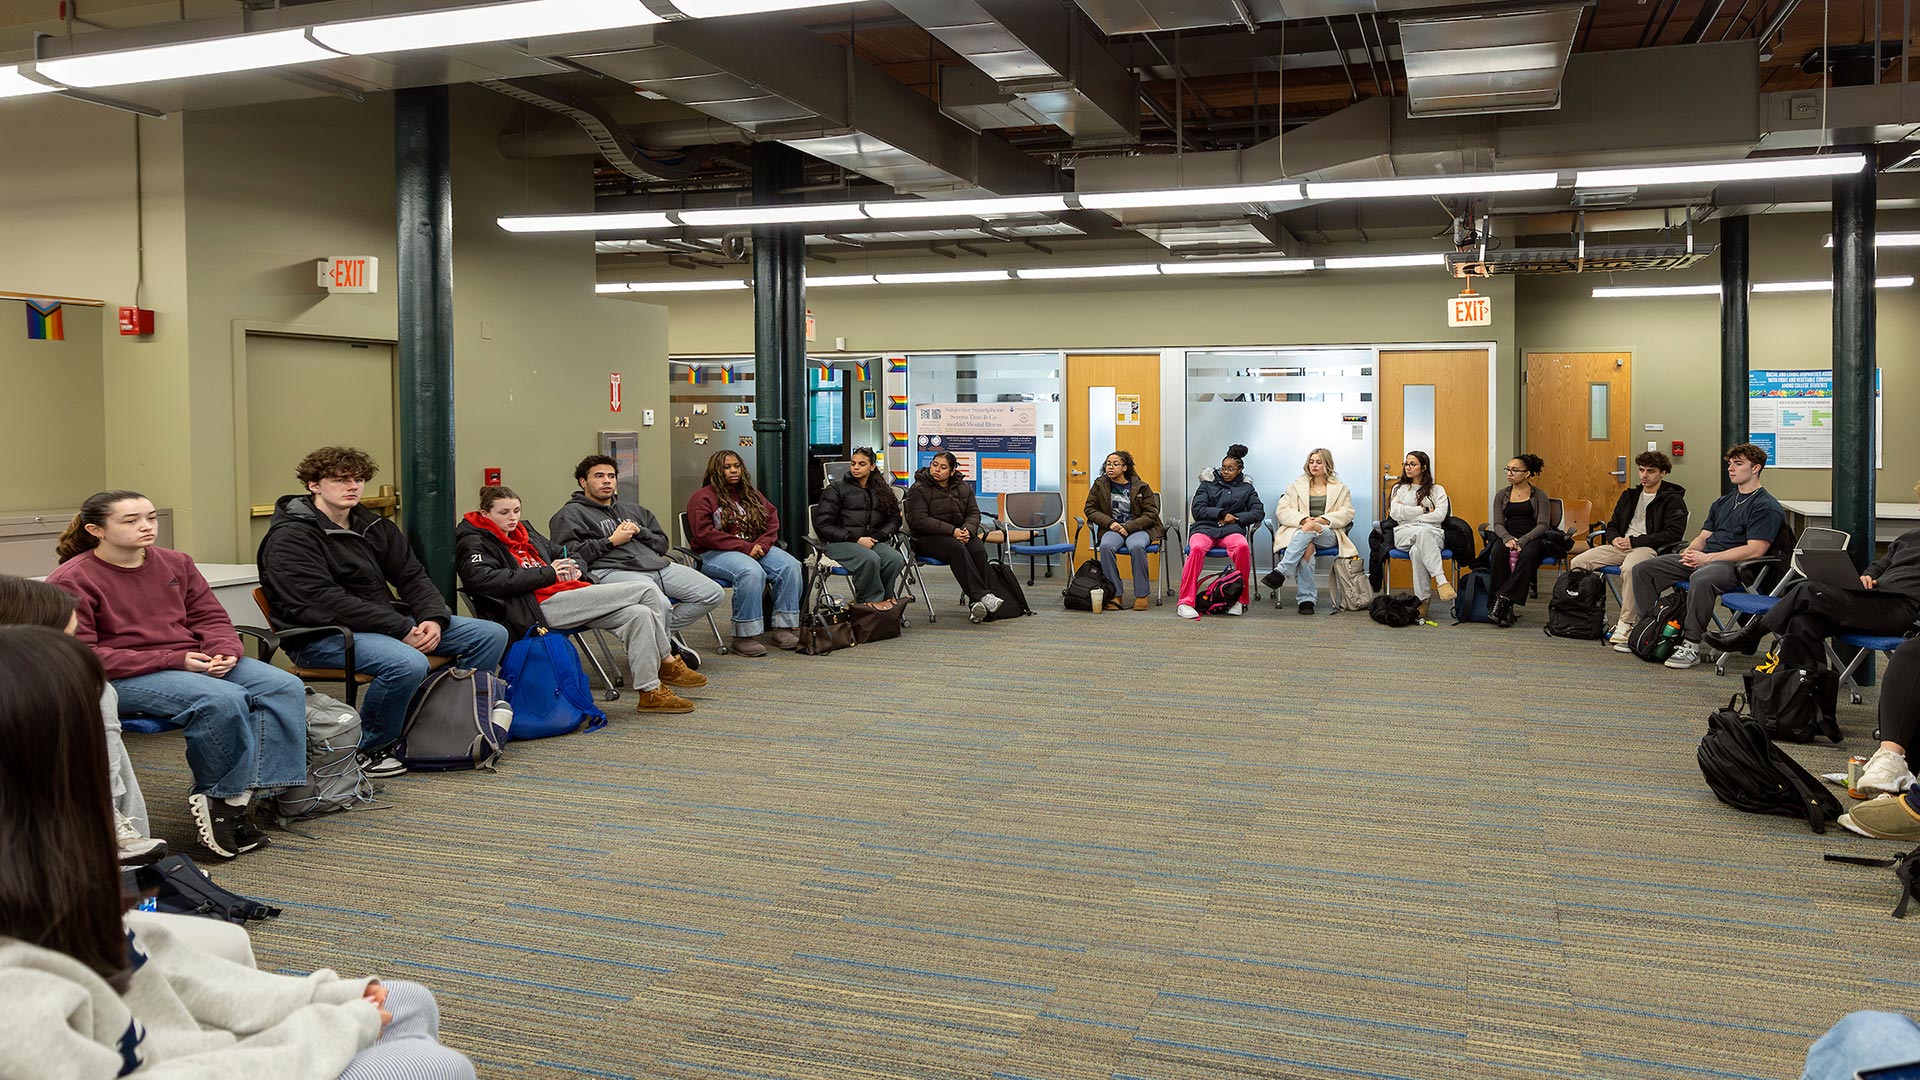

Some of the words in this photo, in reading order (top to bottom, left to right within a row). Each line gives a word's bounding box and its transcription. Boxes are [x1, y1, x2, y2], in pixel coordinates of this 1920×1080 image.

[335, 259, 365, 287] EXIT
[1455, 300, 1485, 322] EXIT
[471, 553, 483, 563] 21
